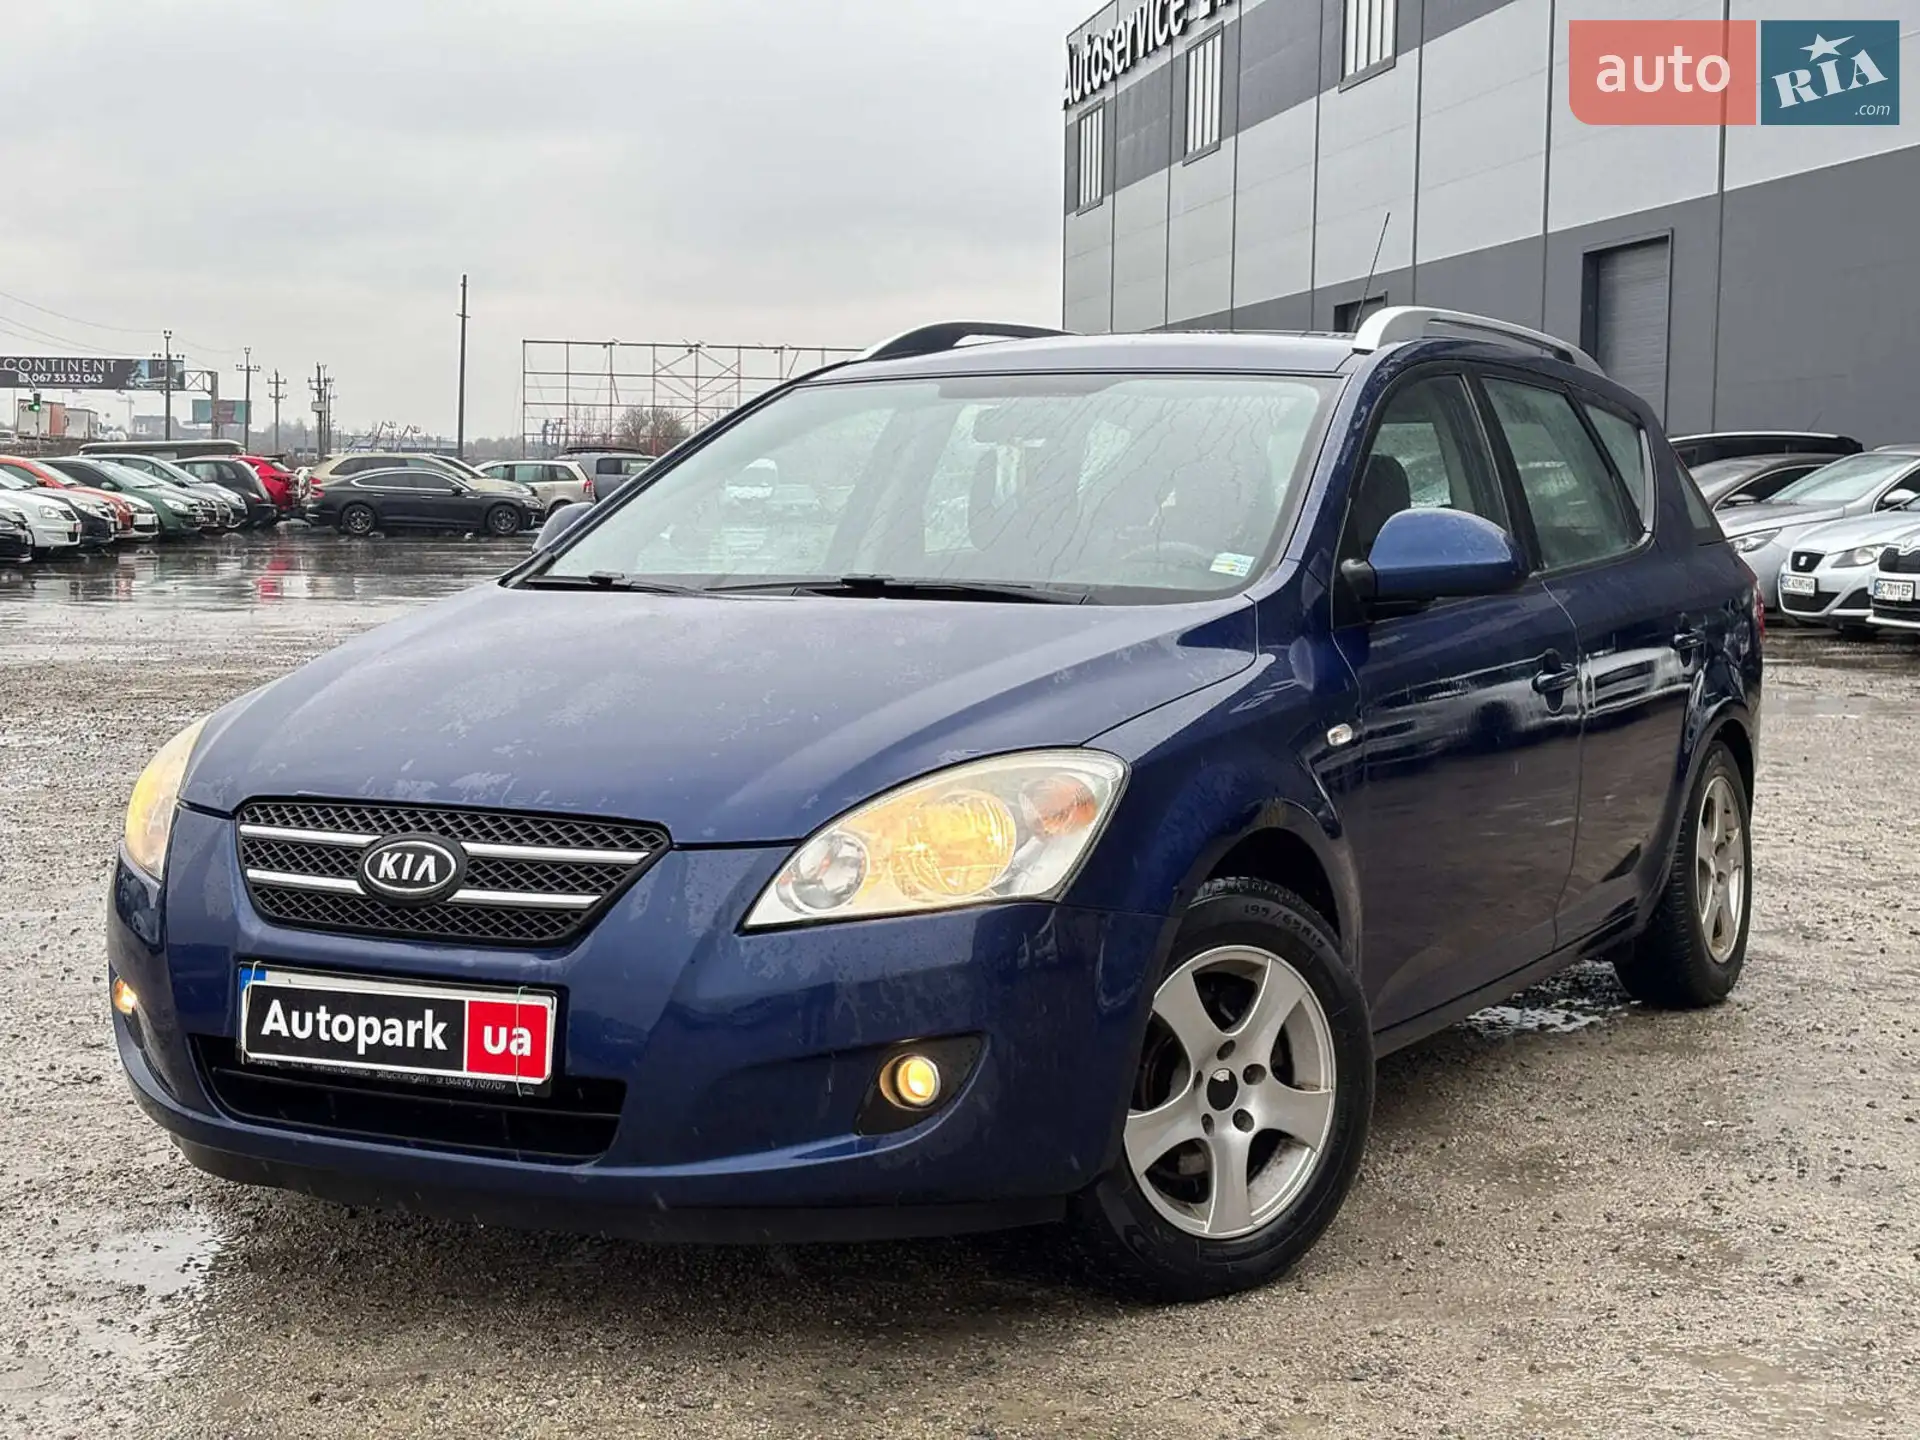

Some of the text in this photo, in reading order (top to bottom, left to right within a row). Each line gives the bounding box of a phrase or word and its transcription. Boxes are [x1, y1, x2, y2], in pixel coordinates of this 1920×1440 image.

[1063, 0, 1185, 106] Autoservice
[3, 358, 117, 374] CONTINENT
[377, 851, 438, 884] KIA
[260, 998, 532, 1057] Autopark ua
